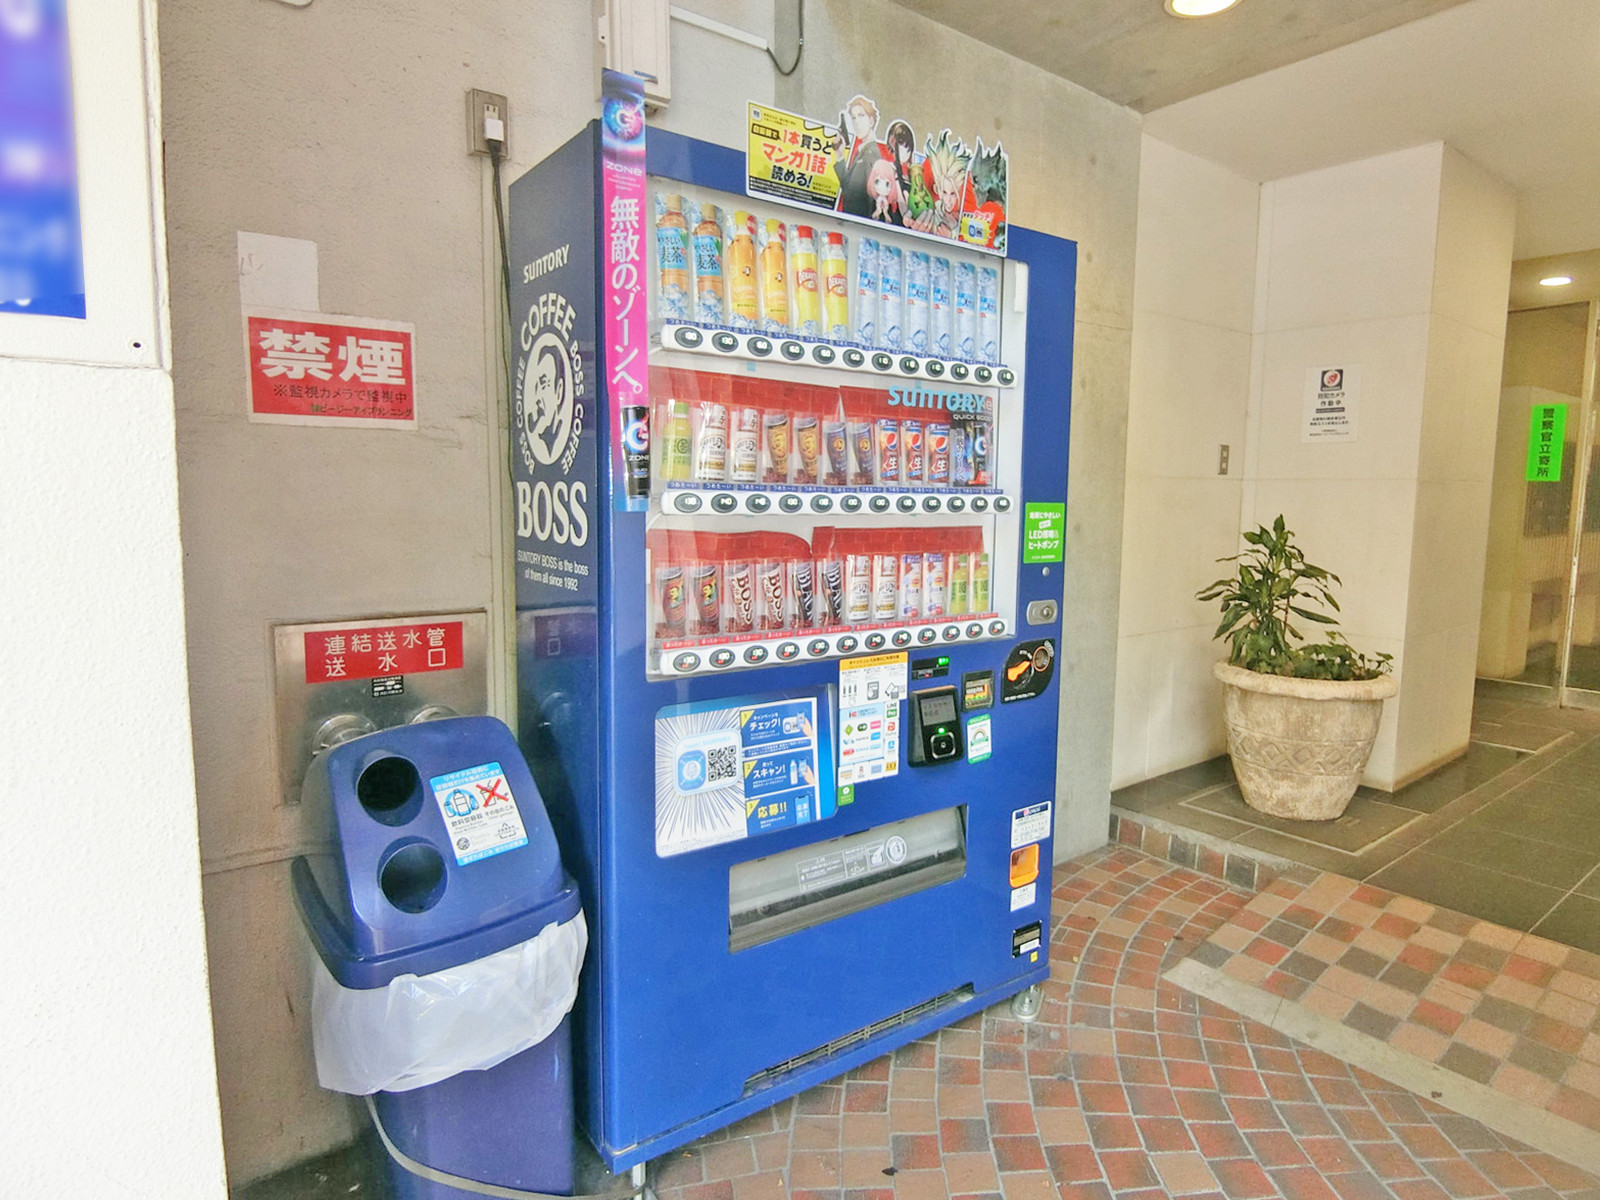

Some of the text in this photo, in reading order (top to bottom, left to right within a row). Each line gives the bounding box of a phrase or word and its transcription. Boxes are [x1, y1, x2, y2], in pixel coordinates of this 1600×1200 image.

[763, 142, 827, 174] マンガ1話
[523, 244, 569, 284] SUNTORY
[610, 195, 643, 394] 無敵のゾーンへ。
[521, 292, 576, 352] COFFEE
[259, 328, 407, 386] 禁煙
[515, 356, 535, 475] BOSS COFFEE
[561, 340, 584, 475] BOSS COFFEE
[888, 385, 988, 413] SUNTORY
[517, 481, 588, 547] BOSS
[518, 549, 589, 576] SUNTORY BOSS is the boss
[525, 568, 530, 578] of
[530, 569, 542, 582] them
[549, 573, 563, 588] since
[564, 576, 578, 591] 1992
[736, 572, 753, 625] BOSS
[768, 571, 783, 622] BOSS
[324, 627, 446, 656] 連結送水管
[326, 648, 446, 678] 送水口
[750, 717, 781, 731] チェック!
[753, 764, 786, 779] スキャン!
